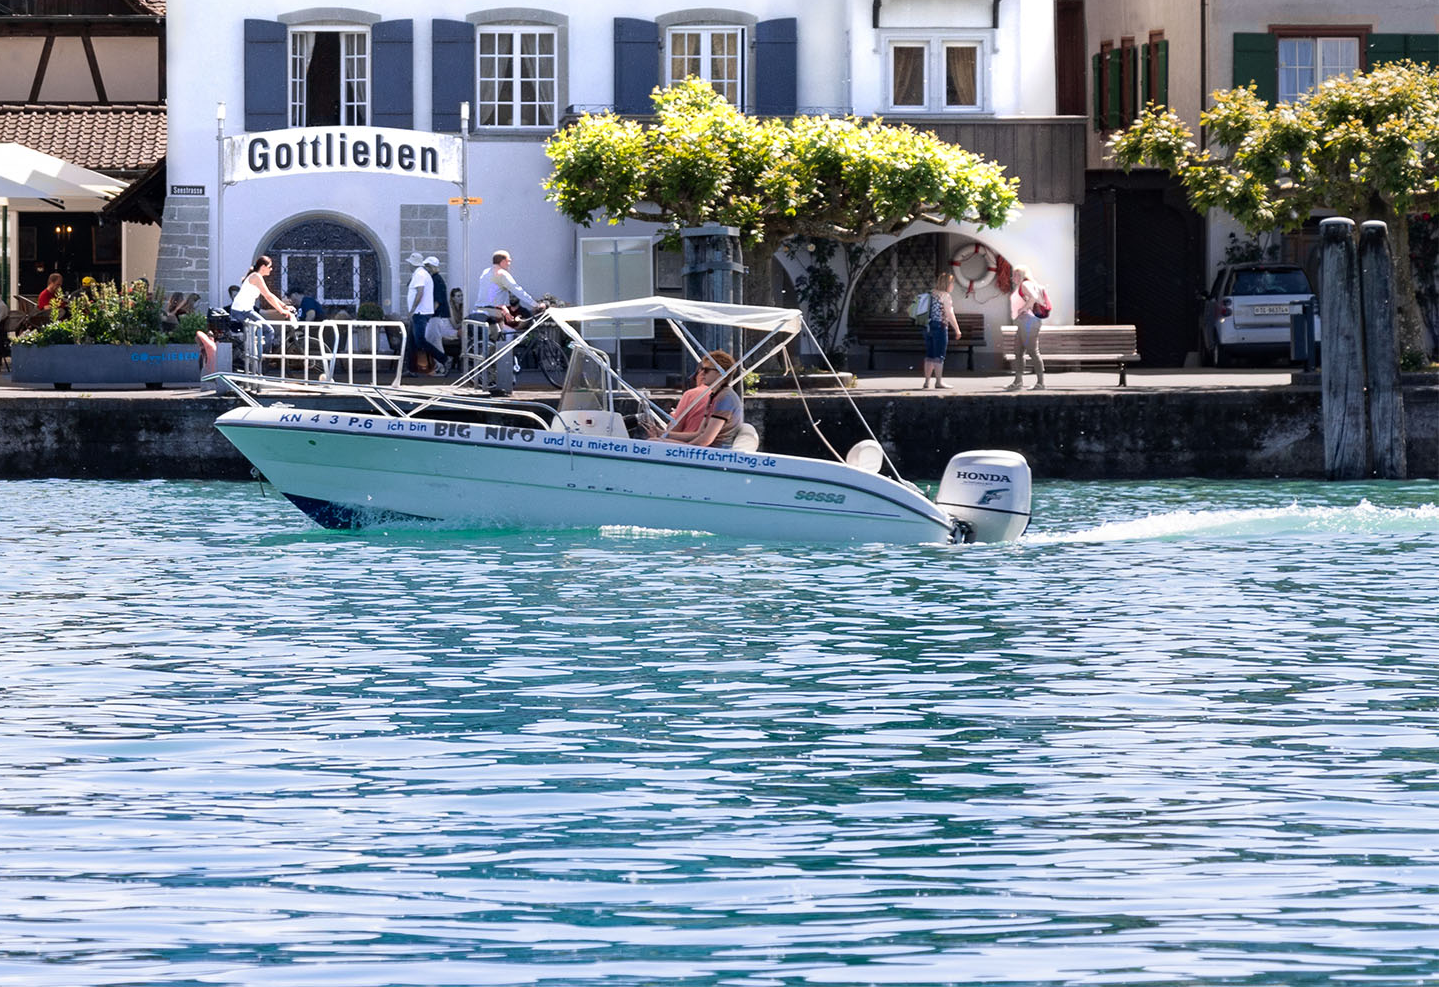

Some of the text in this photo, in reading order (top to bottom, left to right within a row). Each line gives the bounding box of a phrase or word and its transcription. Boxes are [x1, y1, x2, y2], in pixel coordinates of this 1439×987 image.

[248, 132, 440, 174] Gottlieben
[279, 413, 302, 422] KN
[387, 421, 404, 431] ich
[409, 421, 427, 432] bin
[433, 422, 471, 439] BIG
[543, 436, 565, 446] und
[570, 438, 583, 448] zu
[588, 439, 628, 453] mieten
[633, 442, 651, 455] bei
[956, 471, 1012, 483] HONDA
[794, 490, 846, 504] sessa
